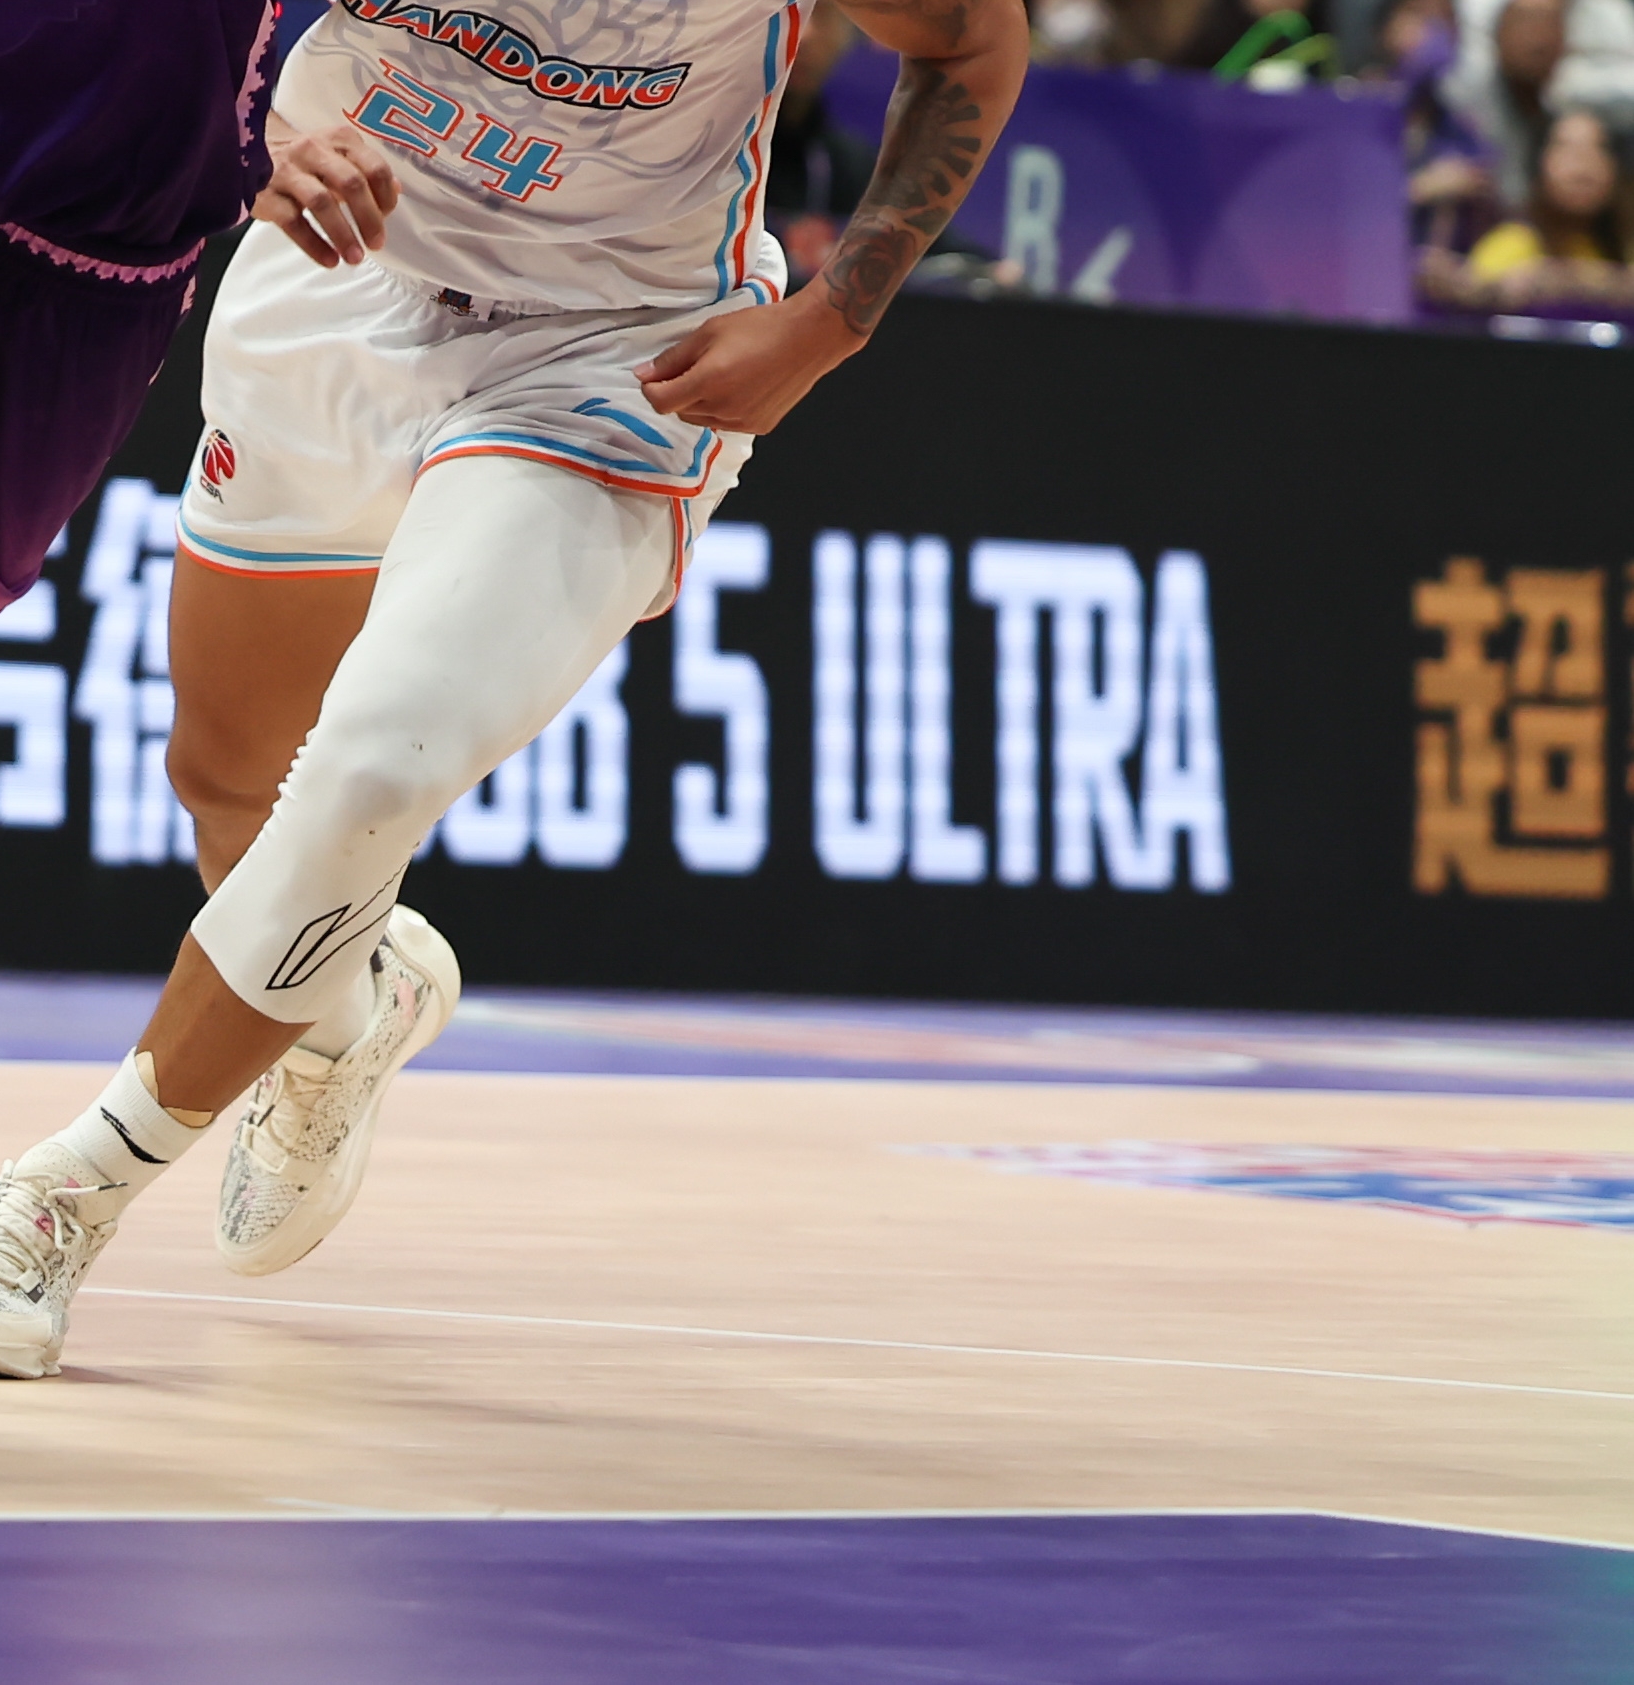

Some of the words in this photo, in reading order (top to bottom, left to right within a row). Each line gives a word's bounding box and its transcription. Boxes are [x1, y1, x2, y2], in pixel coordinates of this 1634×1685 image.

[342, 57, 565, 204] 24
[671, 520, 770, 876] 5
[811, 528, 1234, 894] ULTRA
[1412, 556, 1634, 900] 超
